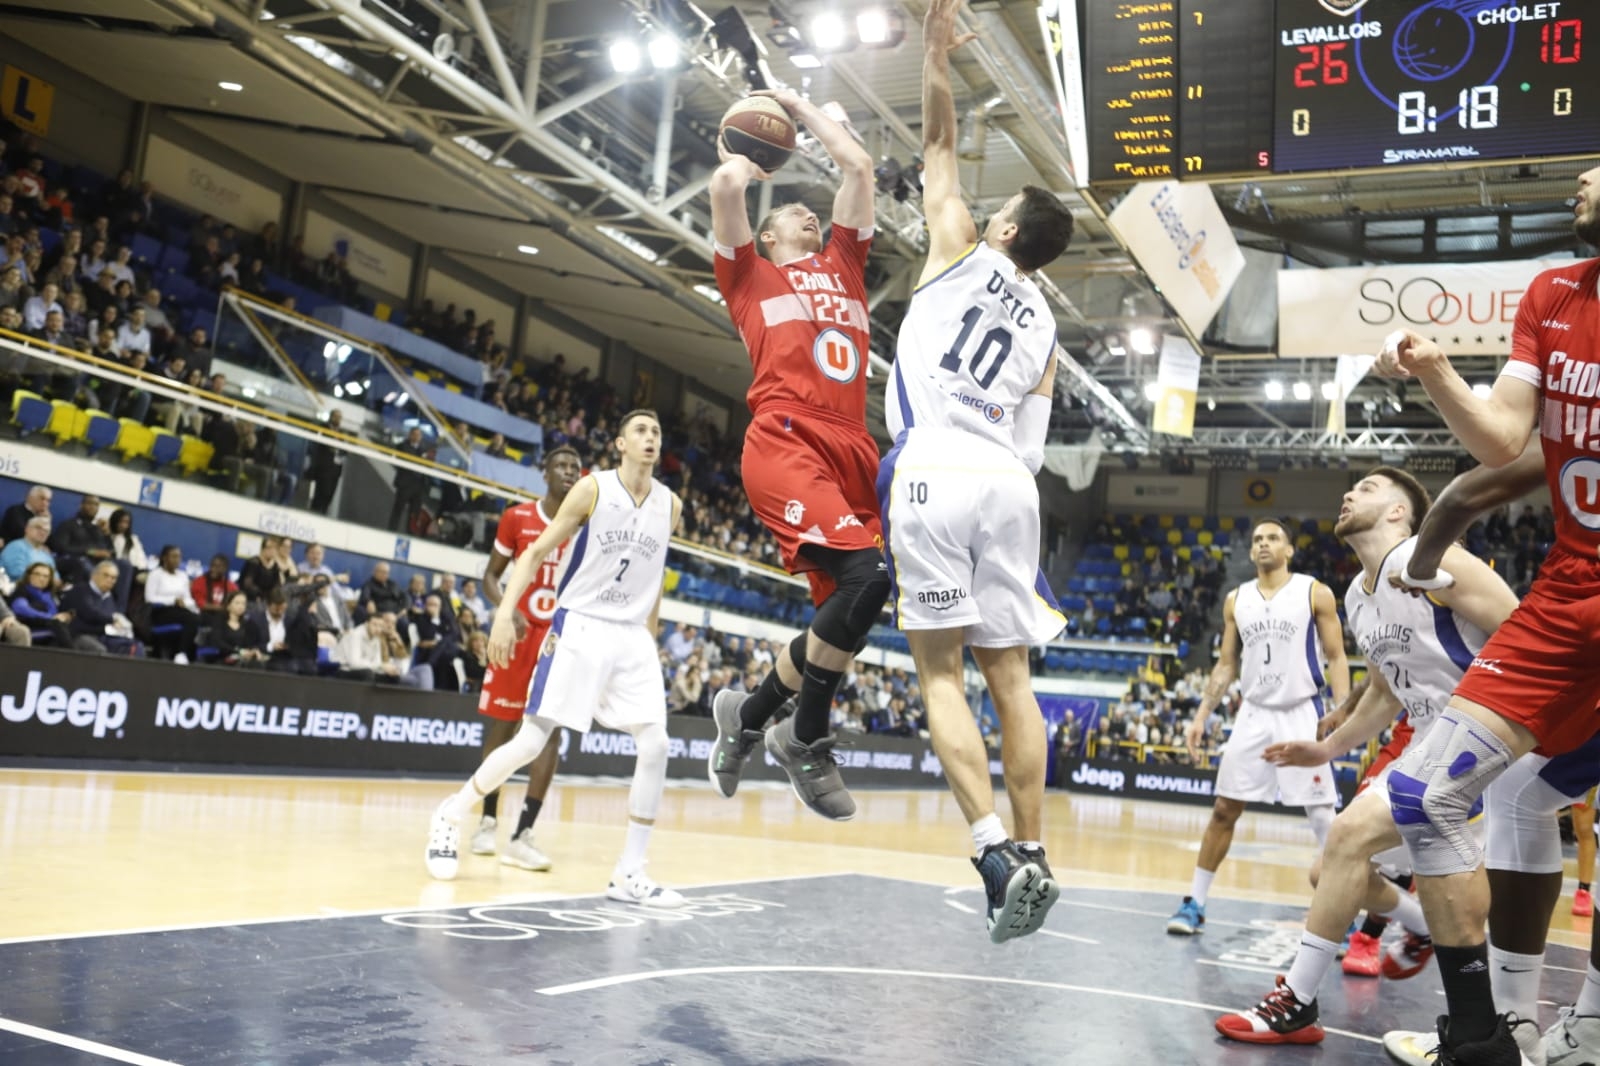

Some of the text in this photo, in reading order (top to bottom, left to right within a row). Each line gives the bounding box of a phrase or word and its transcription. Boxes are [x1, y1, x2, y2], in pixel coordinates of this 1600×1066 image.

[1193, 12, 1204, 26] 7
[1477, 3, 1560, 26] CHOLET
[1281, 21, 1382, 46] LEVALLOIS
[1540, 19, 1583, 64] 10
[1293, 43, 1348, 88] 26
[1553, 88, 1573, 116] 0
[1292, 109, 1311, 136] 0
[1383, 146, 1480, 164] STRAMATEL
[814, 293, 851, 326] 22
[939, 305, 1013, 391] 10
[909, 481, 928, 505] 10
[615, 559, 630, 582] 7
[1, 671, 128, 738] Jeep
[155, 697, 300, 736] NOUVELLE
[371, 714, 484, 747] RENEGADE
[1072, 763, 1213, 795] Jeep NOUVELLE
